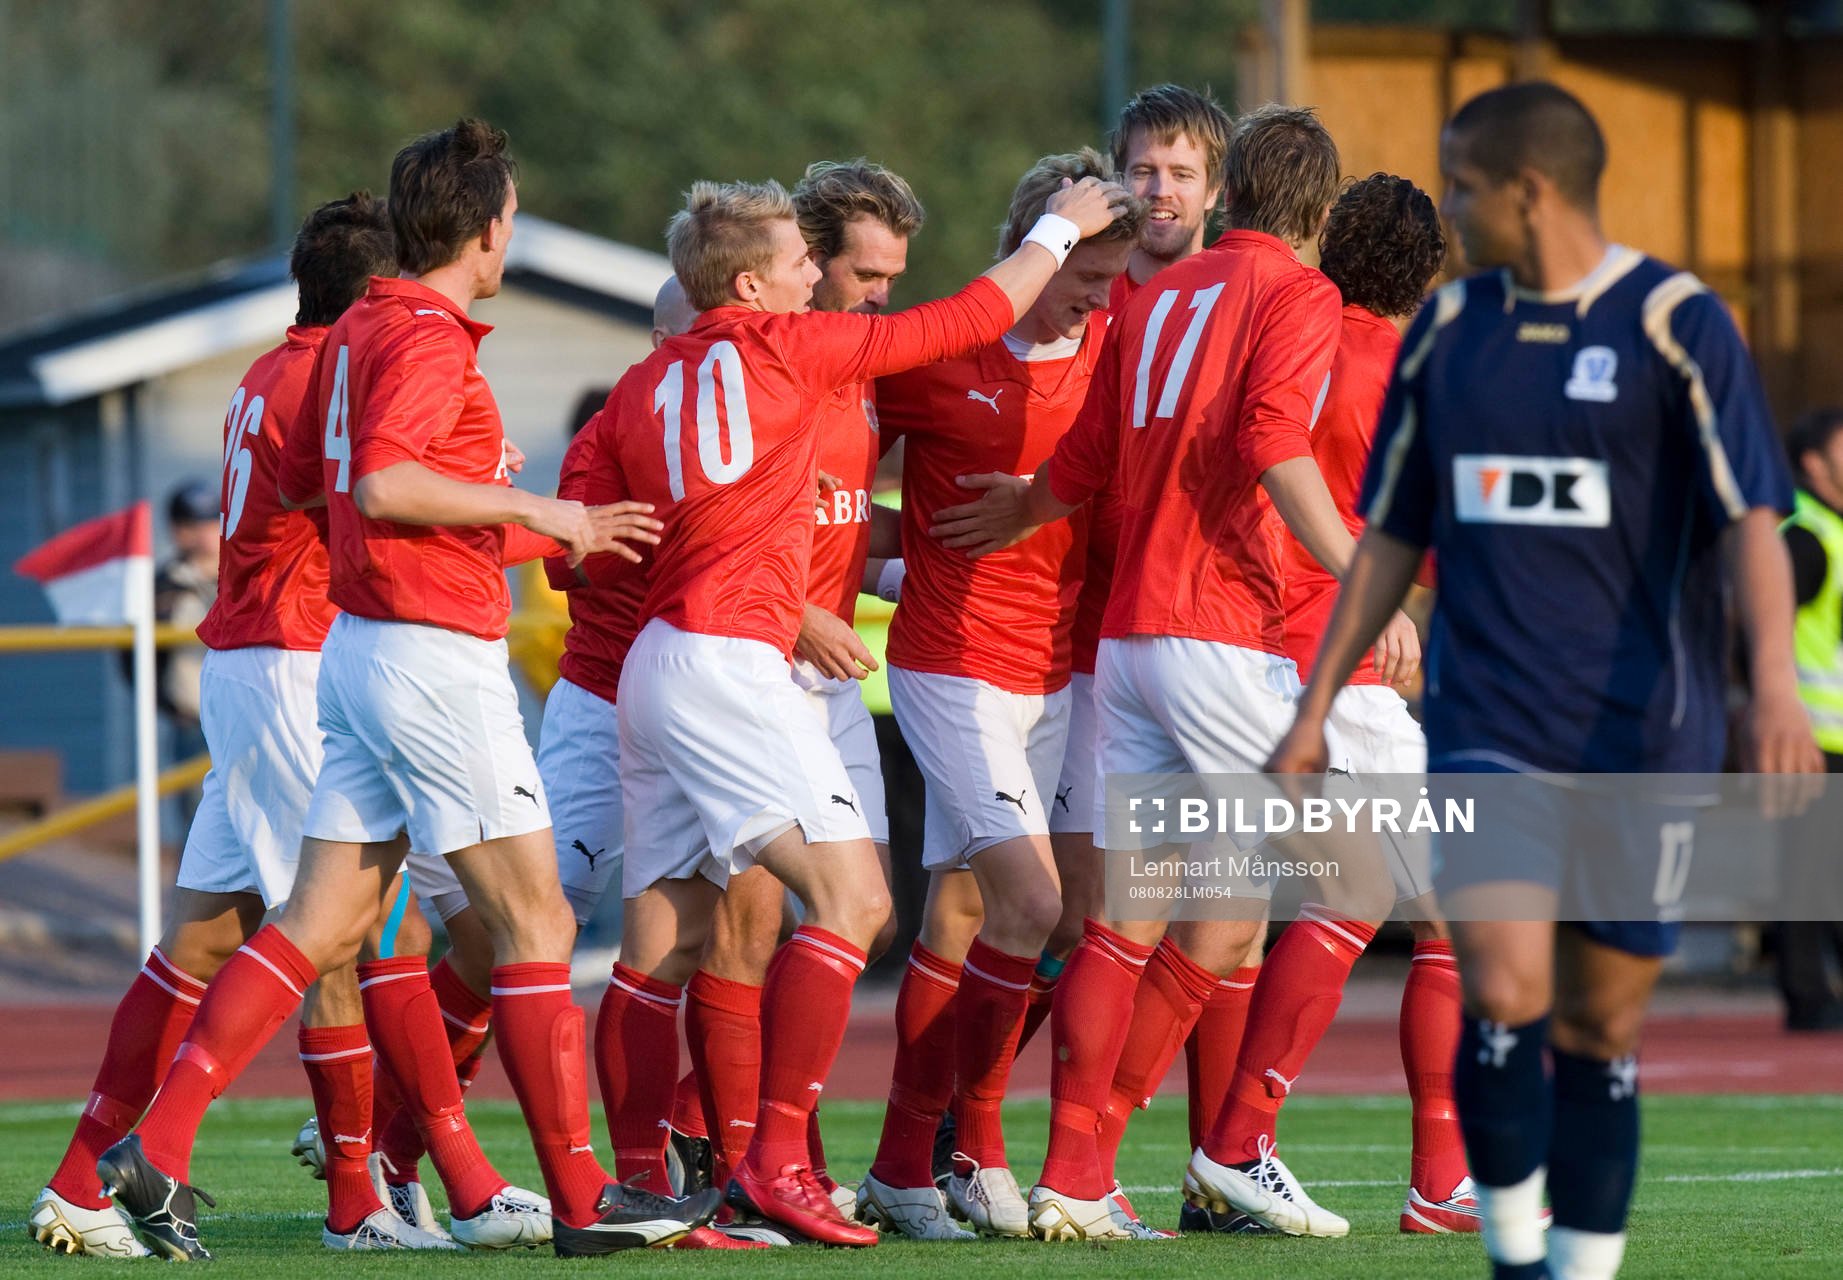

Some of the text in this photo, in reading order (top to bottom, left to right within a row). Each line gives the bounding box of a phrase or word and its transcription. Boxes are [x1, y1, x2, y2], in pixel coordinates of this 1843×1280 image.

[324, 345, 351, 493] 4
[654, 340, 754, 503] 10
[1133, 282, 1226, 428] 11
[219, 386, 264, 541] 26
